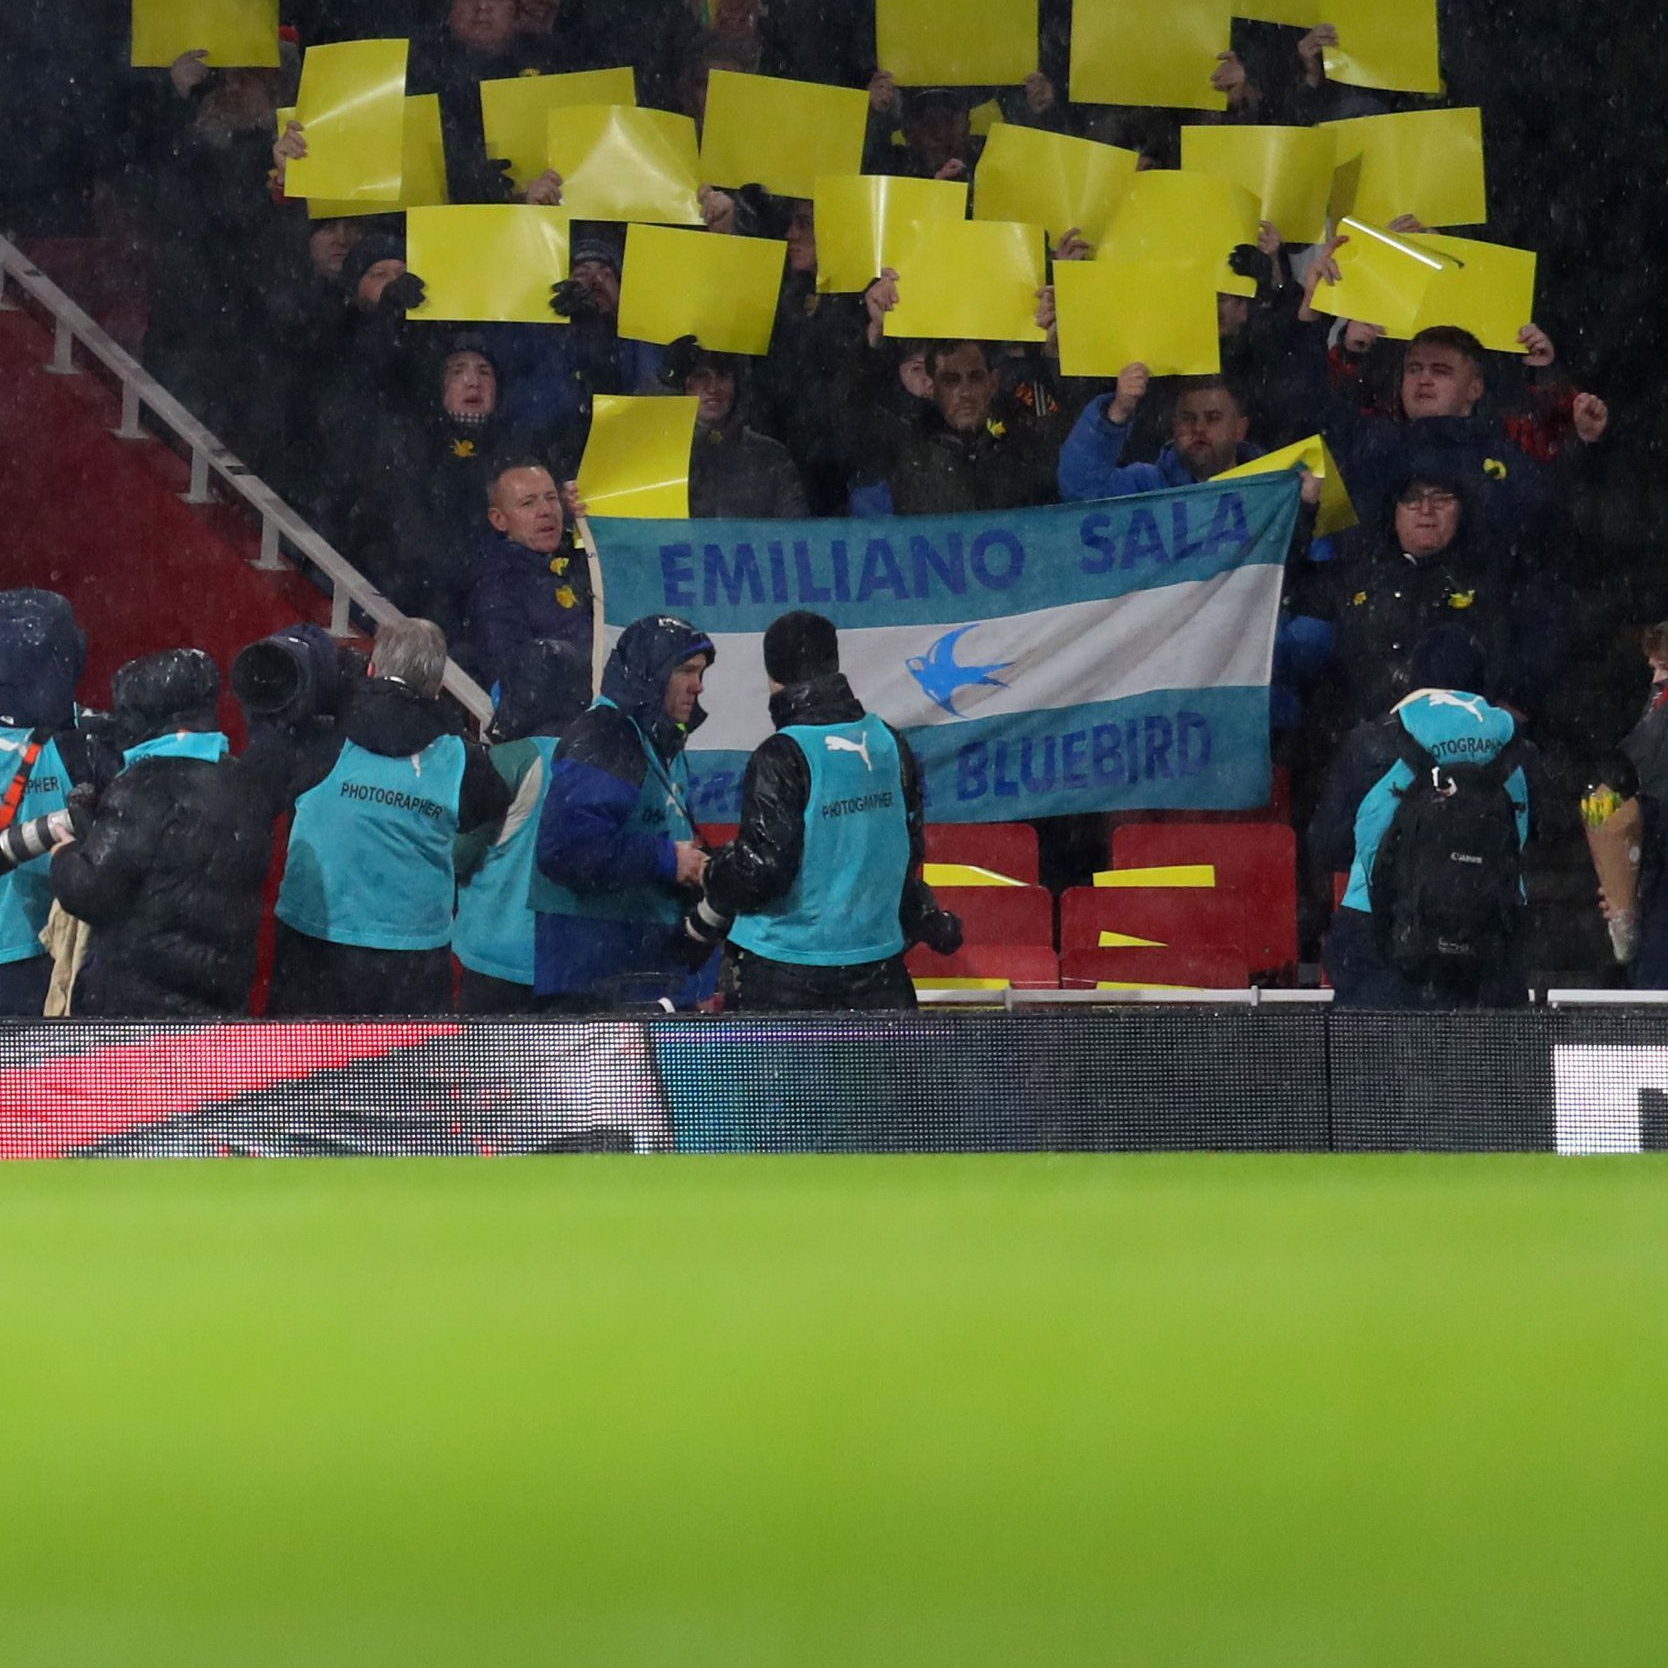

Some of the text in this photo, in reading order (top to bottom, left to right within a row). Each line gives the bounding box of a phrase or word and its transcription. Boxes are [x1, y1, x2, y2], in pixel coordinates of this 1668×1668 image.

[658, 492, 1253, 608] EMILIANO SALA
[340, 781, 443, 820] PHOTOGRAPHER
[956, 710, 1212, 802] BLUEBIRD
